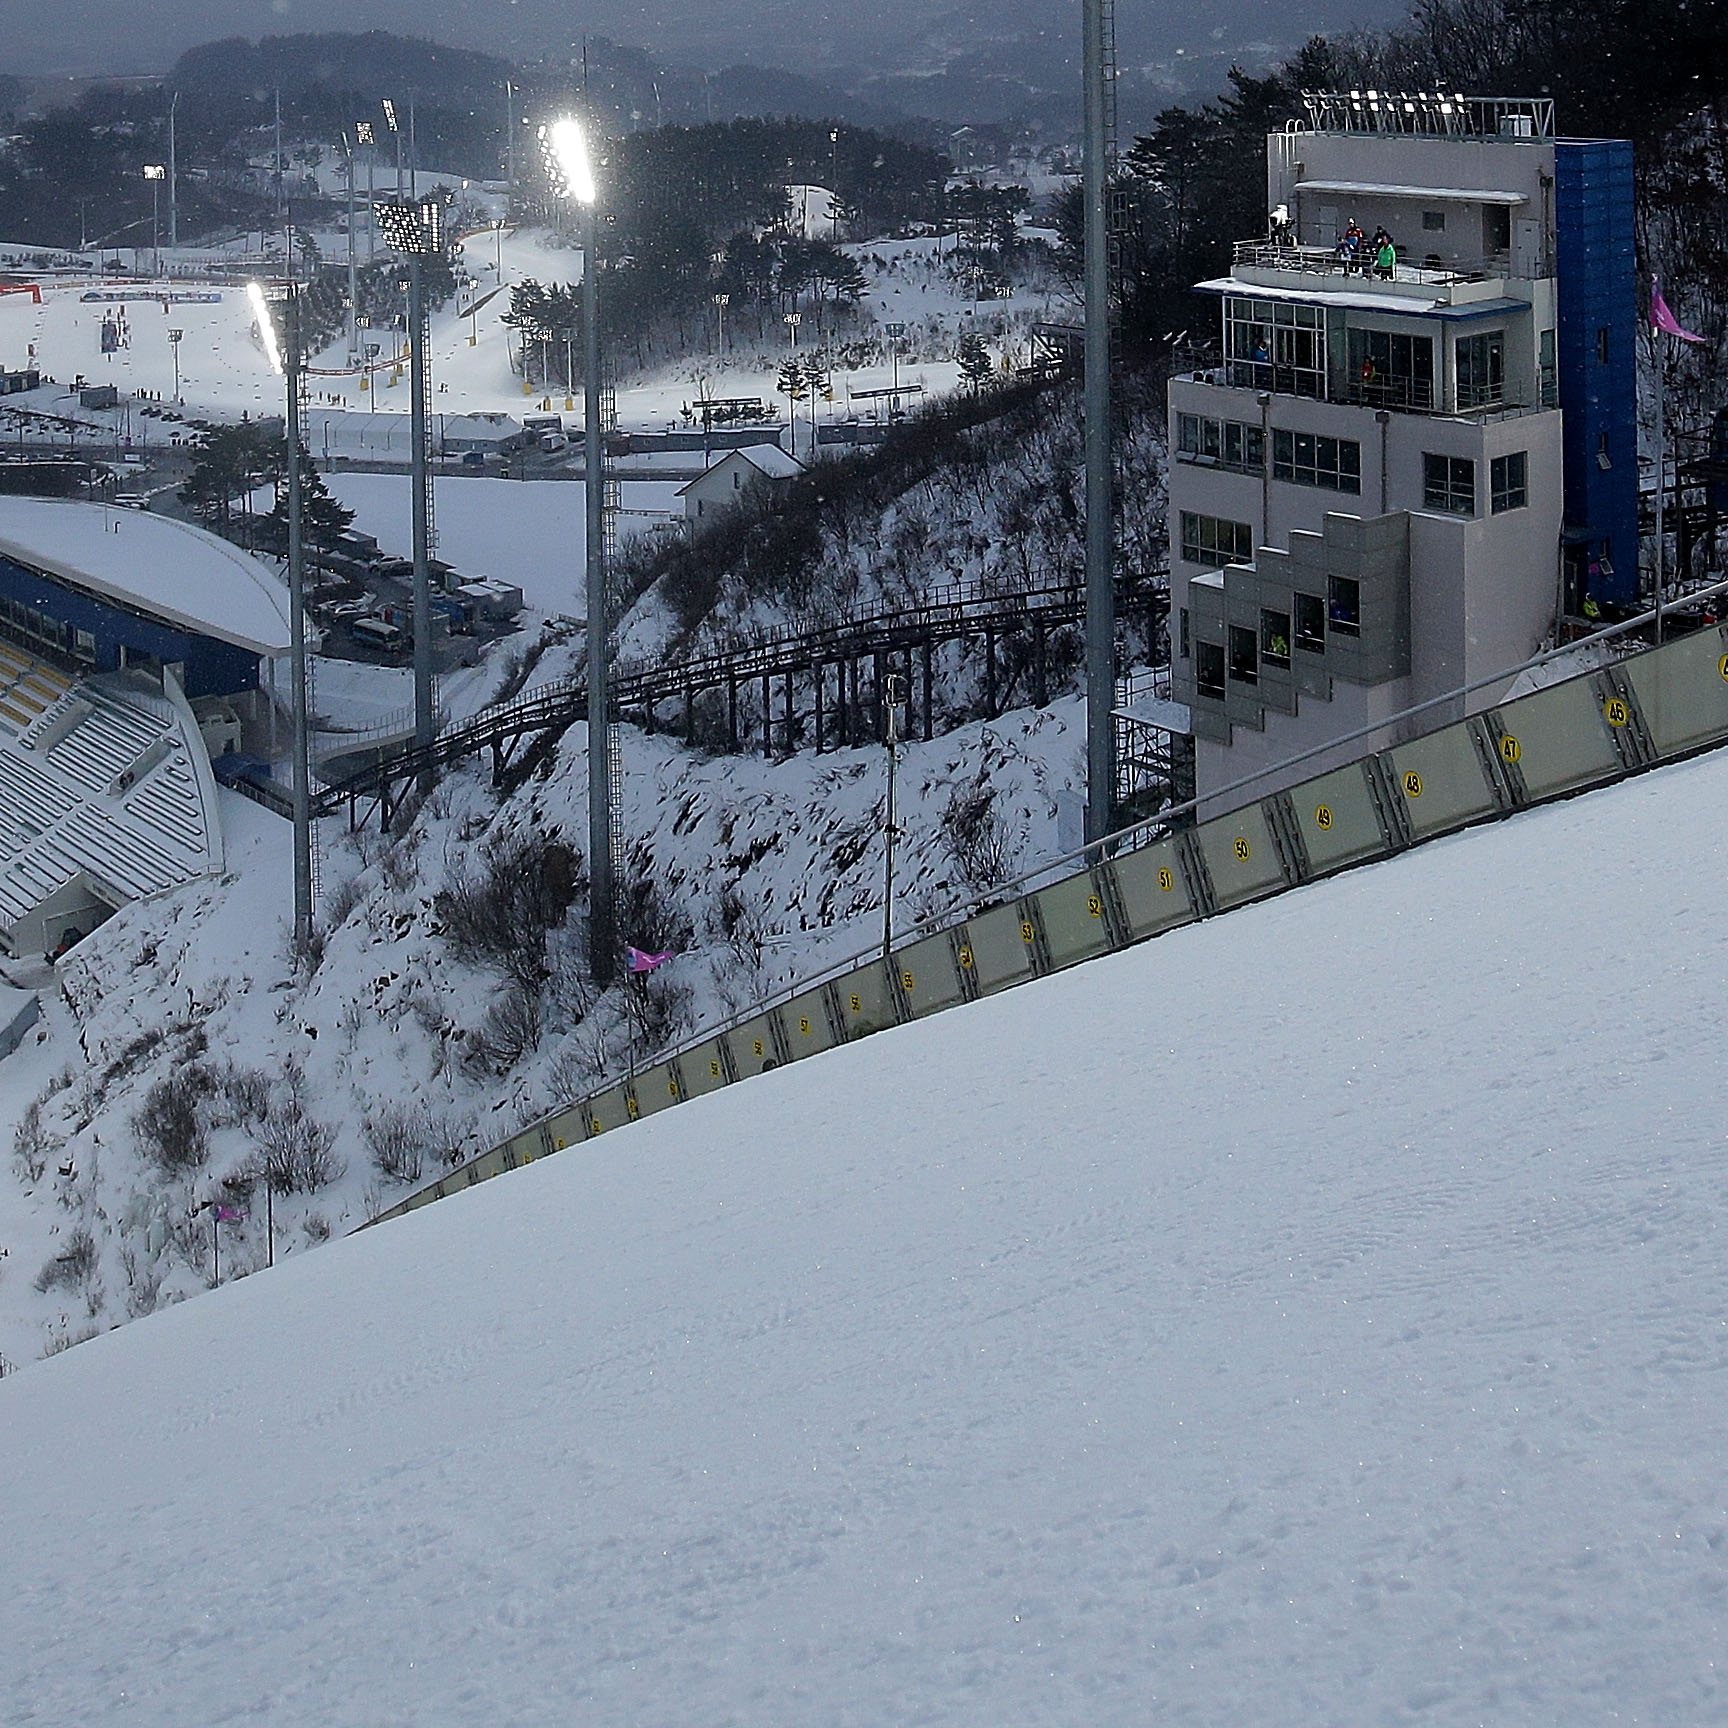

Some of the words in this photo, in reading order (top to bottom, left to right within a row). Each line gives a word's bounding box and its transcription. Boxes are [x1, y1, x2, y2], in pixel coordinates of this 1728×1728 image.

[1609, 701, 1625, 722] 46
[1503, 738, 1519, 759] 47
[1406, 775, 1420, 794] 48
[1318, 808, 1332, 826] 49
[1236, 840, 1248, 858] 50
[1160, 871, 1172, 888] 51
[1090, 898, 1101, 916] 52
[1023, 924, 1034, 940] 53
